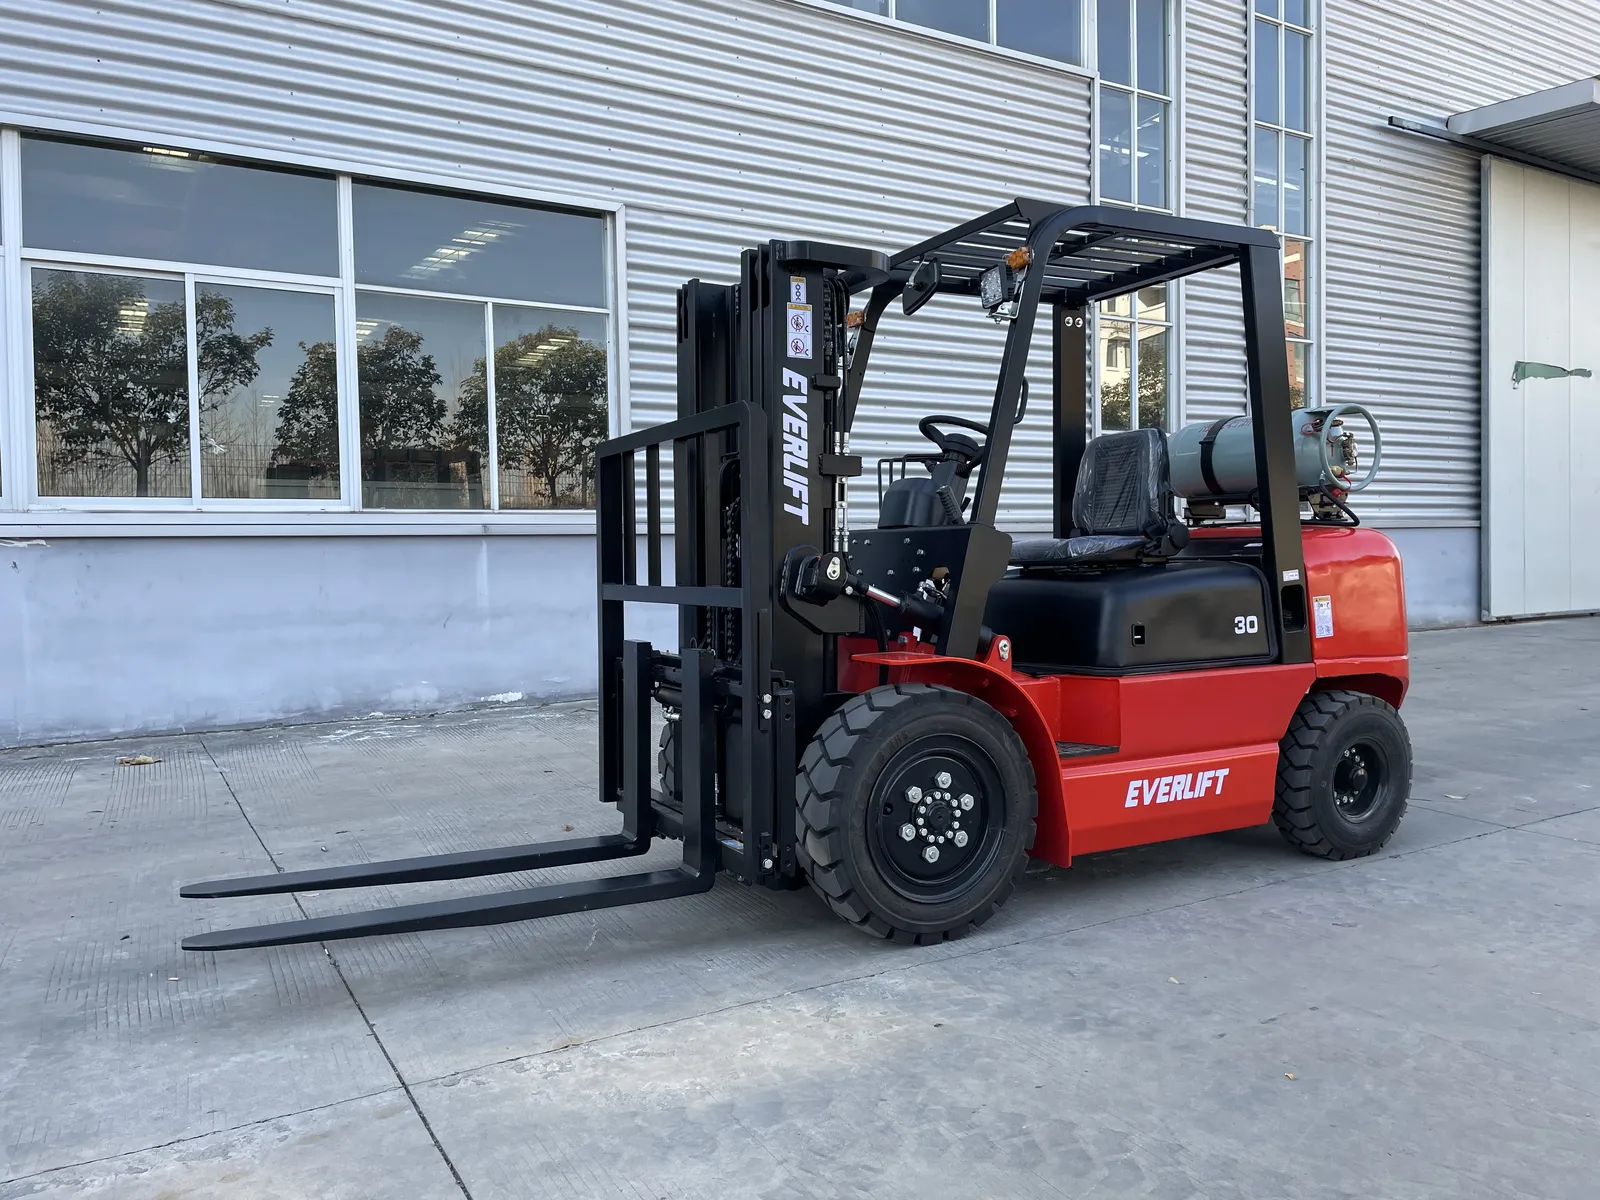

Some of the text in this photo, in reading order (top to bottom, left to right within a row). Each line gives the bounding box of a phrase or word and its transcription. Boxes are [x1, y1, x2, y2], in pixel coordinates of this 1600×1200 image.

[782, 367, 809, 526] EVERLIFT
[1234, 615, 1258, 634] 30
[1124, 768, 1230, 808] EVERLIFT
